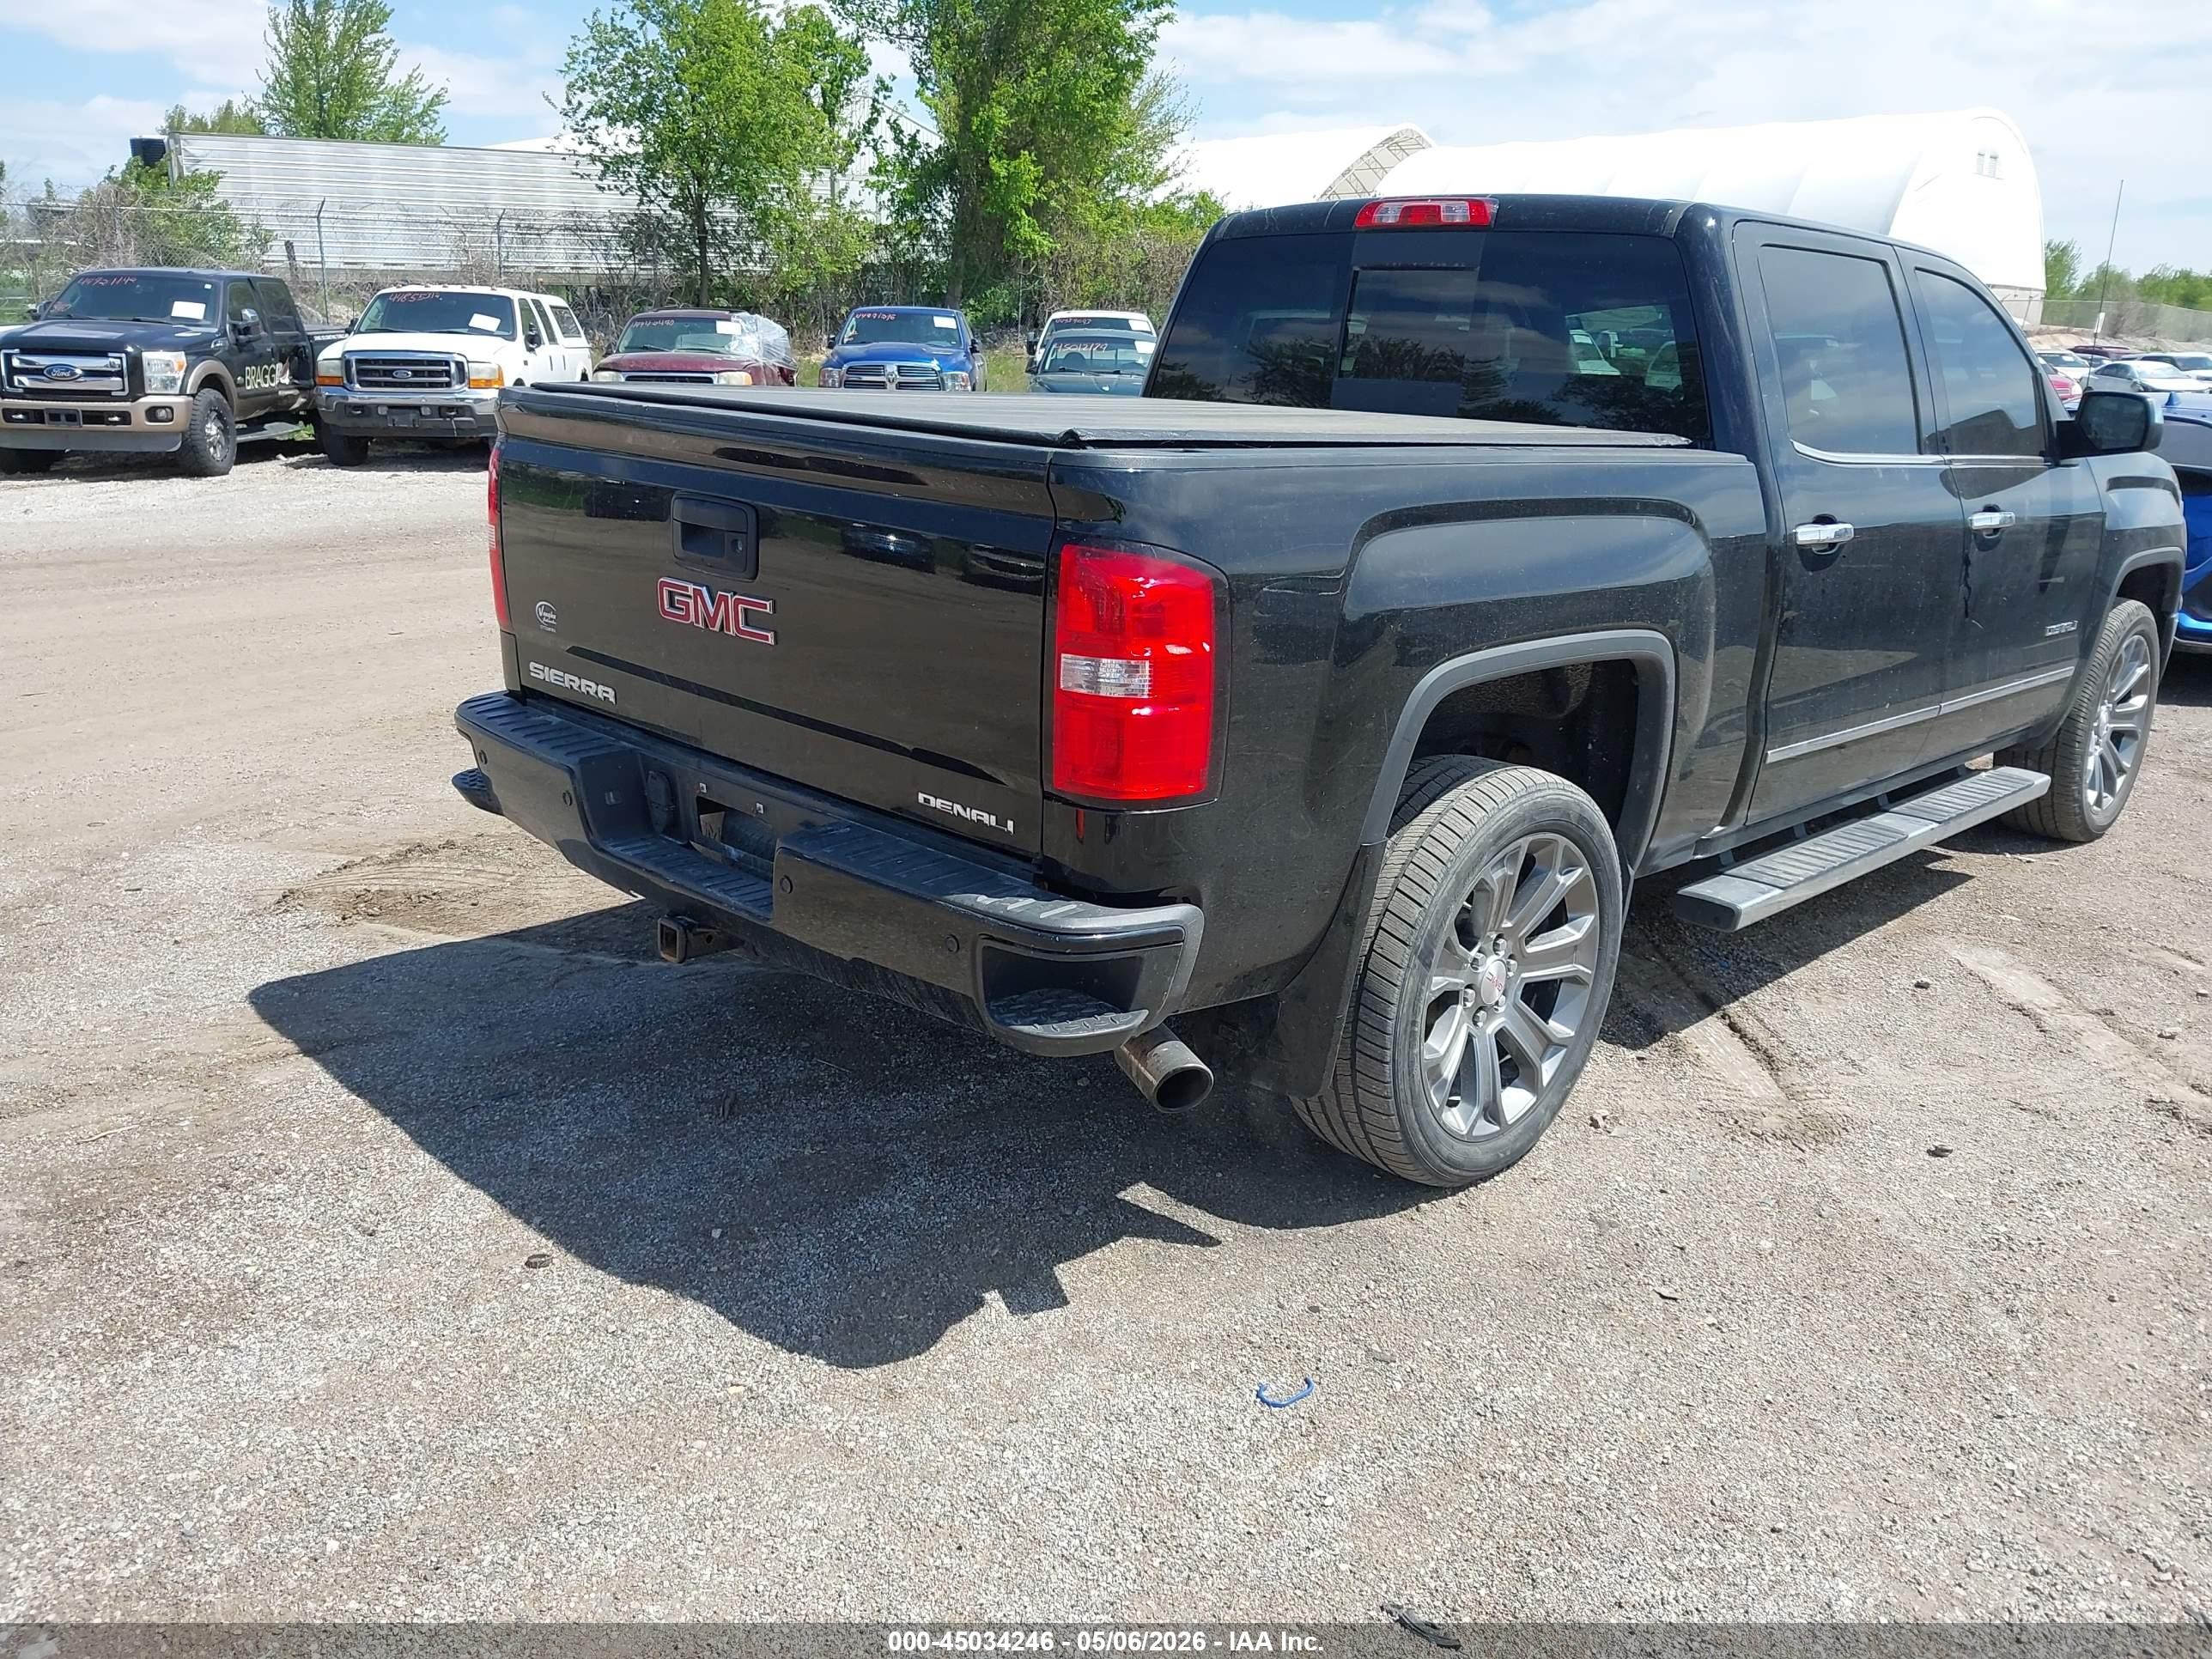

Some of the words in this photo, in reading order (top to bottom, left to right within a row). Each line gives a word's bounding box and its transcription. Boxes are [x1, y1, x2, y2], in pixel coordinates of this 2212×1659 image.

[657, 576, 777, 645] GMC
[529, 660, 617, 705] SIERRA
[917, 791, 1015, 836] DENALI
